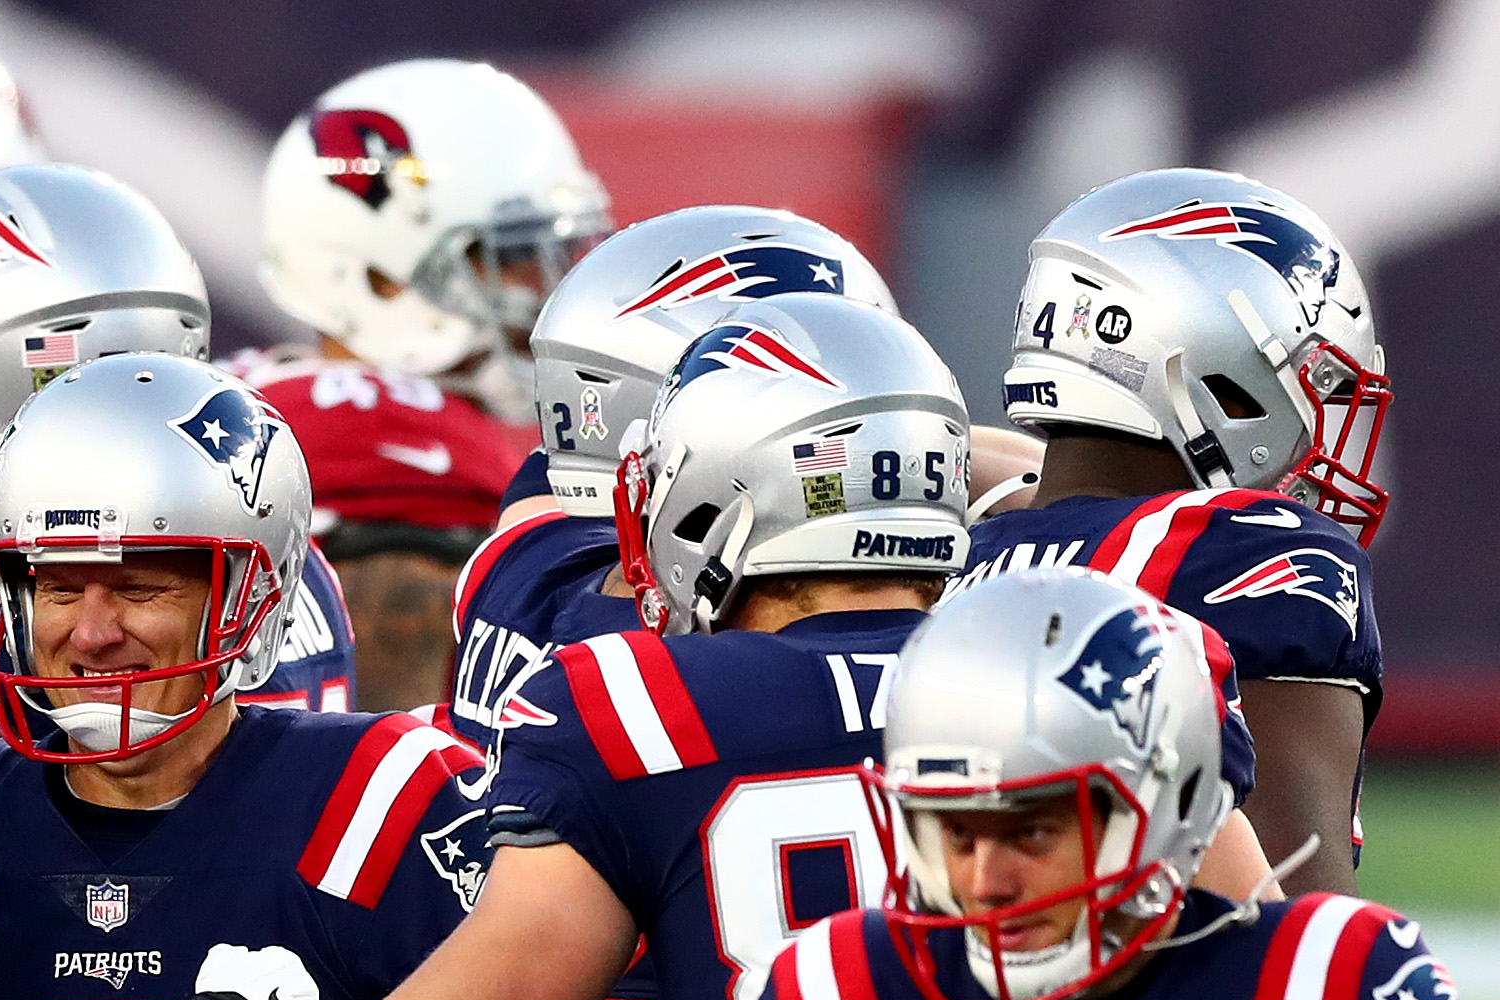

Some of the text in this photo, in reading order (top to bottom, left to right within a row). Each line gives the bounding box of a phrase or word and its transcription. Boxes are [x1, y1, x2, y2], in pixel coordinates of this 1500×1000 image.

[1098, 311, 1129, 338] AR
[45, 510, 101, 531] PATRIOTS
[852, 529, 955, 561] PATRIOTS
[94, 905, 122, 921] NFL
[54, 951, 162, 978] PATRIOTS
